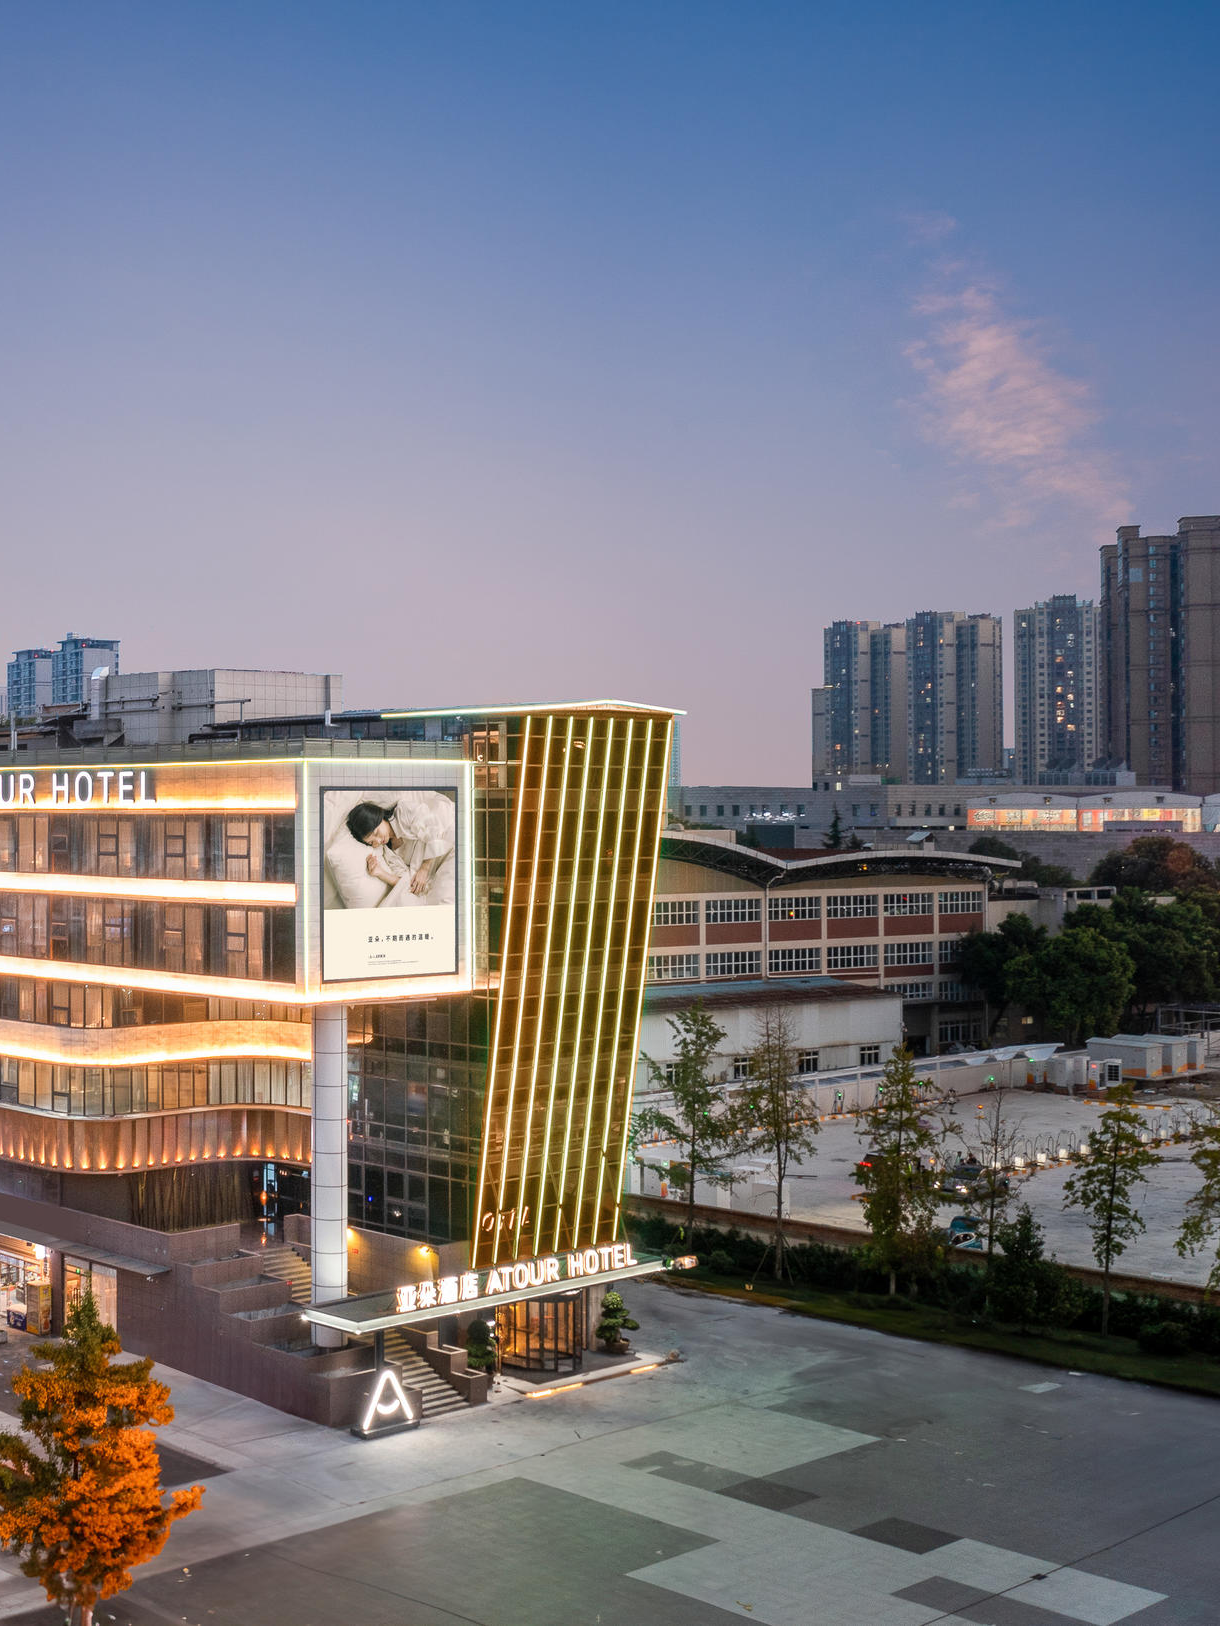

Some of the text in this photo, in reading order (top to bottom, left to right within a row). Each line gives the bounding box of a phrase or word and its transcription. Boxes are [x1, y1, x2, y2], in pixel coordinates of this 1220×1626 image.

[52, 770, 157, 805] HOTEL
[396, 1243, 638, 1313] 亚朵酒店 ATOUR HOTEL
